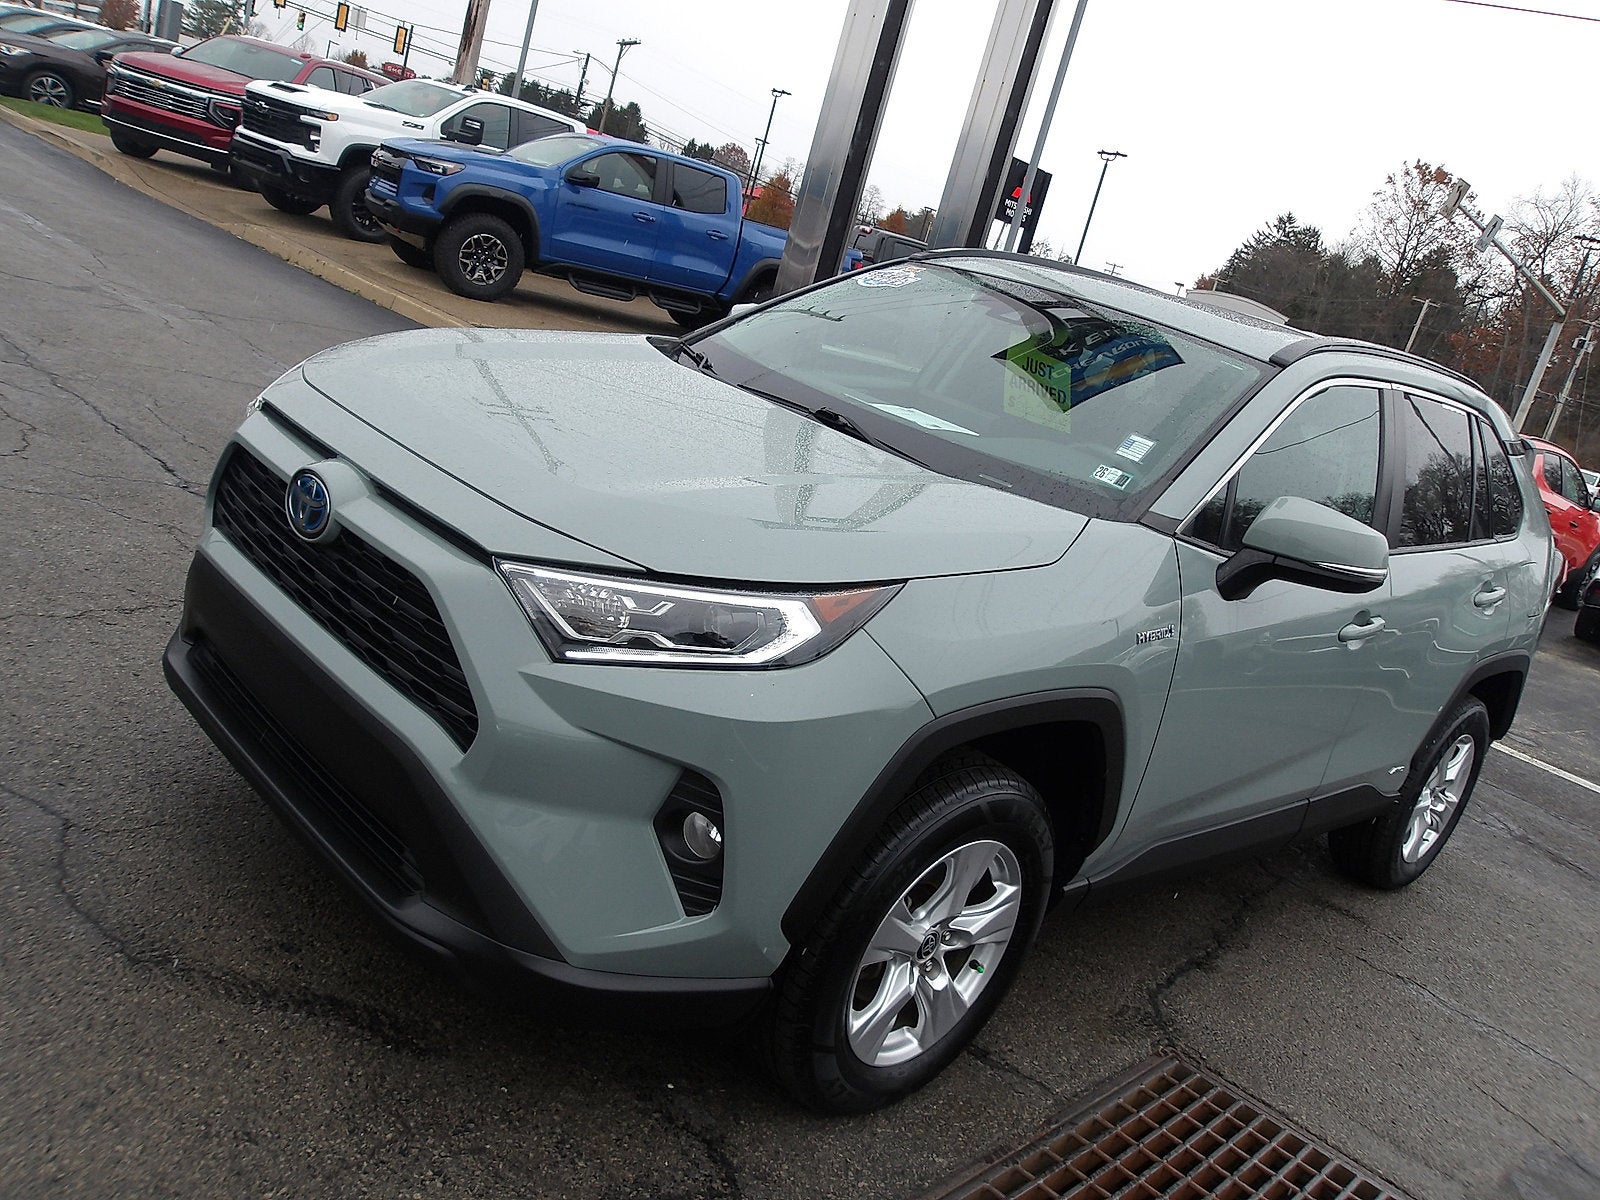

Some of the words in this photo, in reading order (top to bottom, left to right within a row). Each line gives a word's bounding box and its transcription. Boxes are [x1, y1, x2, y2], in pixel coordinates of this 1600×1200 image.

[1004, 199, 1033, 215] MITSSHI
[1022, 356, 1055, 380] JUST
[1009, 375, 1067, 404] ARRIVED
[1094, 465, 1109, 478] 26
[1136, 626, 1172, 645] HYBRID
